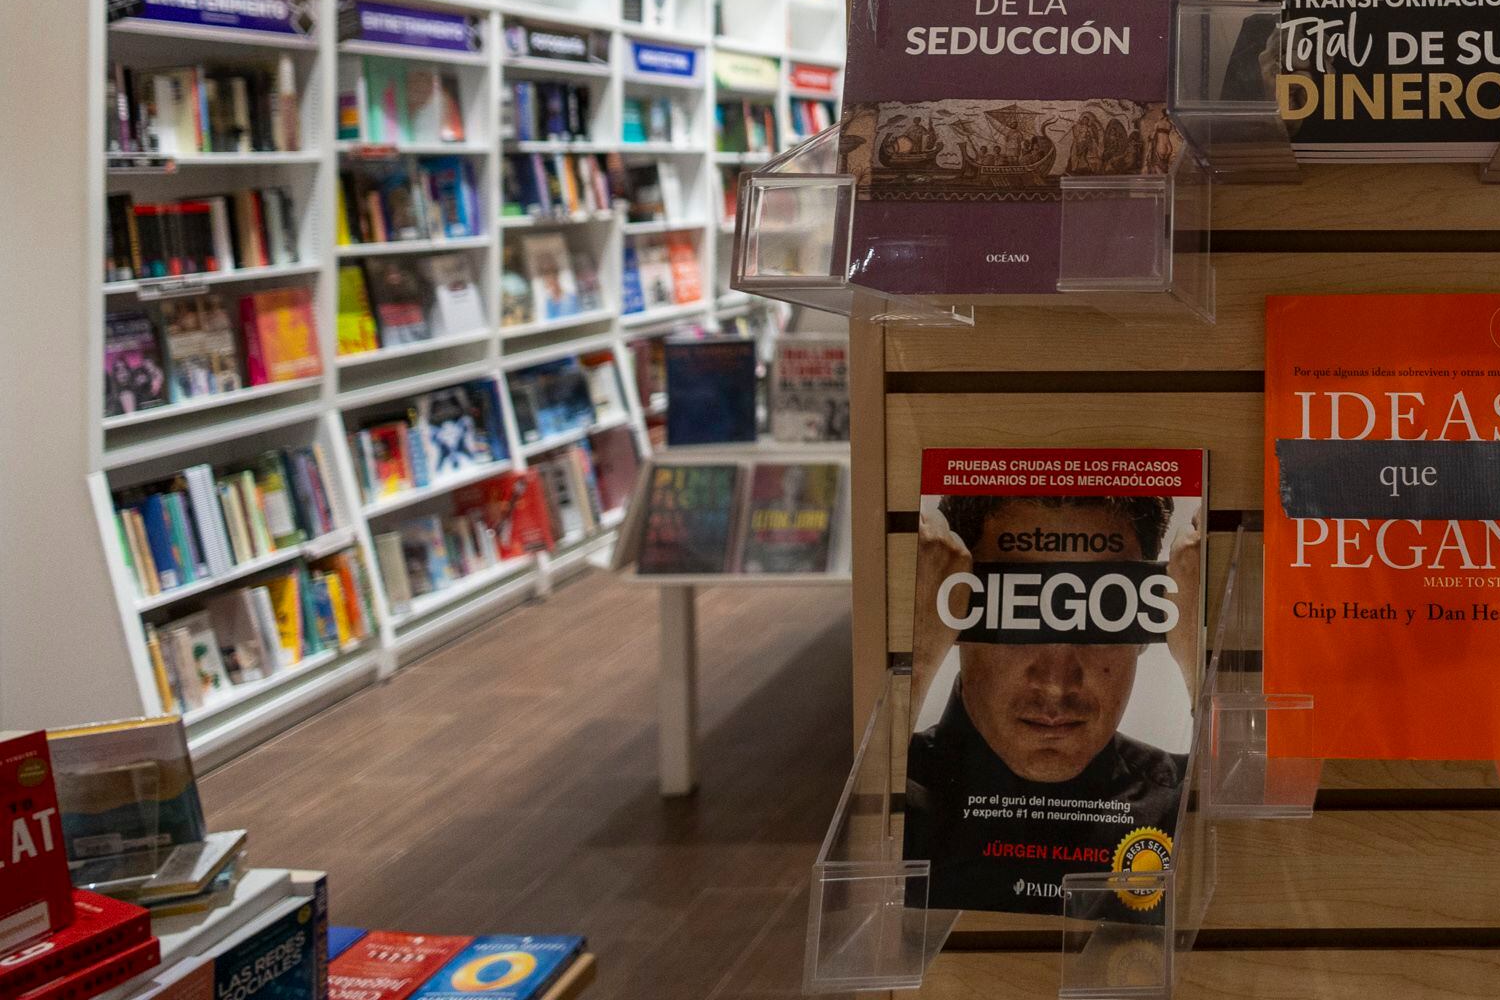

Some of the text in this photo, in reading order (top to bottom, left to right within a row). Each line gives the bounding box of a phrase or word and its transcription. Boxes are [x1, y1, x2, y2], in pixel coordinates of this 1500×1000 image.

[905, 20, 1131, 55] SEDUCCIÓN
[1387, 31, 1445, 66] DE
[986, 251, 1029, 263] OCÉANO
[1293, 366, 1311, 376] Por
[1314, 367, 1331, 379] qué
[1333, 366, 1369, 380] algunas
[1371, 367, 1396, 376] ideas
[1398, 367, 1449, 377] sobreviven
[1451, 369, 1458, 380] y
[1460, 368, 1485, 377] otras
[947, 460, 1179, 472] PRUEBAS CRUDAS DE LOS FRACASOS
[943, 474, 1182, 487] BILLONARIOS DE LOS MERCADÓLOGOS
[1379, 465, 1438, 497] que
[998, 527, 1124, 552] estamos
[1423, 576, 1462, 588] MADE
[1465, 577, 1484, 588] TO
[936, 572, 1180, 633] CIEGOS
[1292, 601, 1337, 624] Chip
[1343, 602, 1397, 620] Heath
[1405, 608, 1416, 626] y
[1427, 603, 1466, 621] Dan
[968, 795, 1131, 813] por el gurú del neuromarketing
[963, 808, 1134, 824] y experto #1 en neuroinnovación
[983, 839, 1110, 862] JÜRGEN KLARIC
[1126, 841, 1146, 860] BEST
